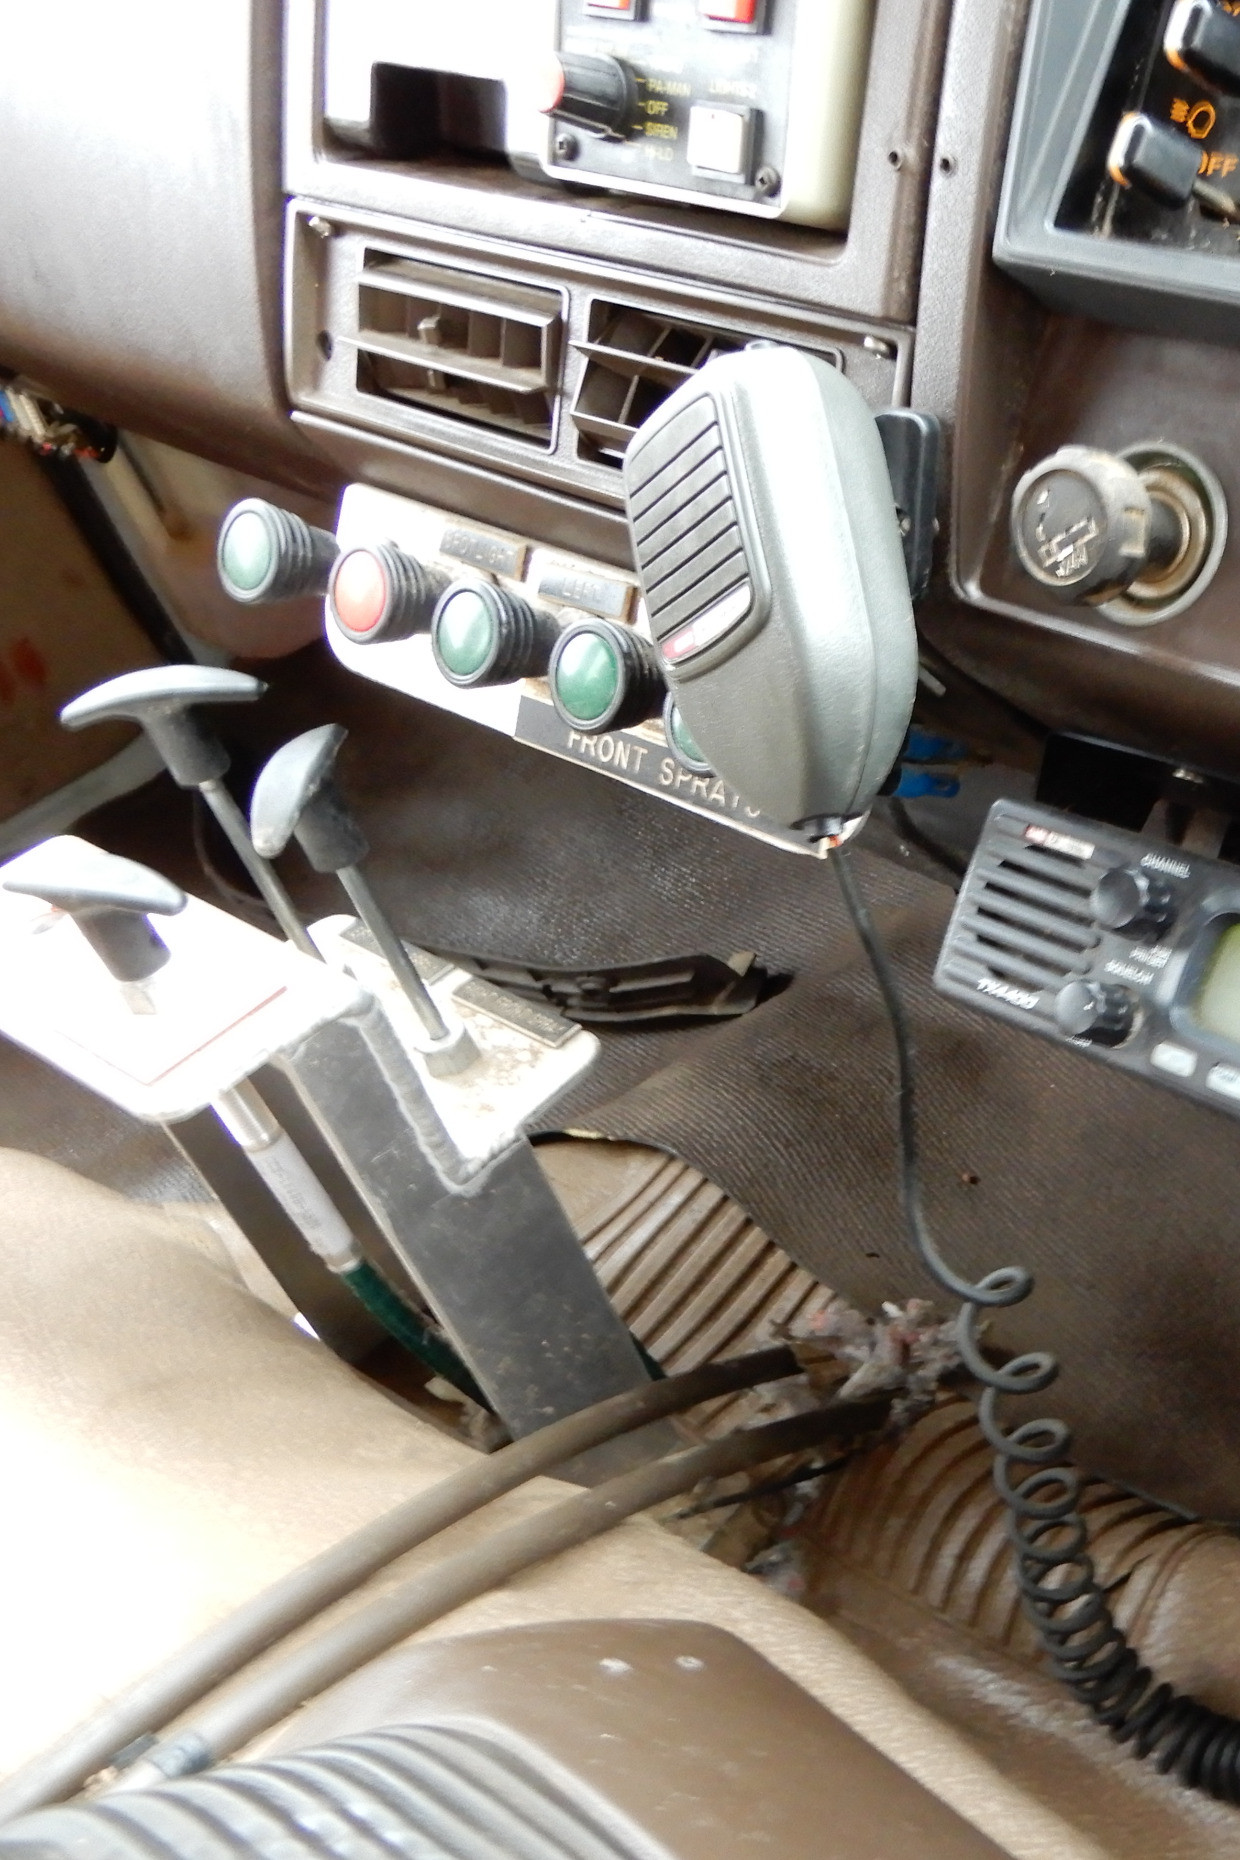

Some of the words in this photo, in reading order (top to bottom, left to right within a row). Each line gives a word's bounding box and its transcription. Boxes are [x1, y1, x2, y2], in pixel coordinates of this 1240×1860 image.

[647, 101, 669, 116] OFF
[567, 730, 649, 774] FRONT
[658, 757, 762, 818] SPRA
